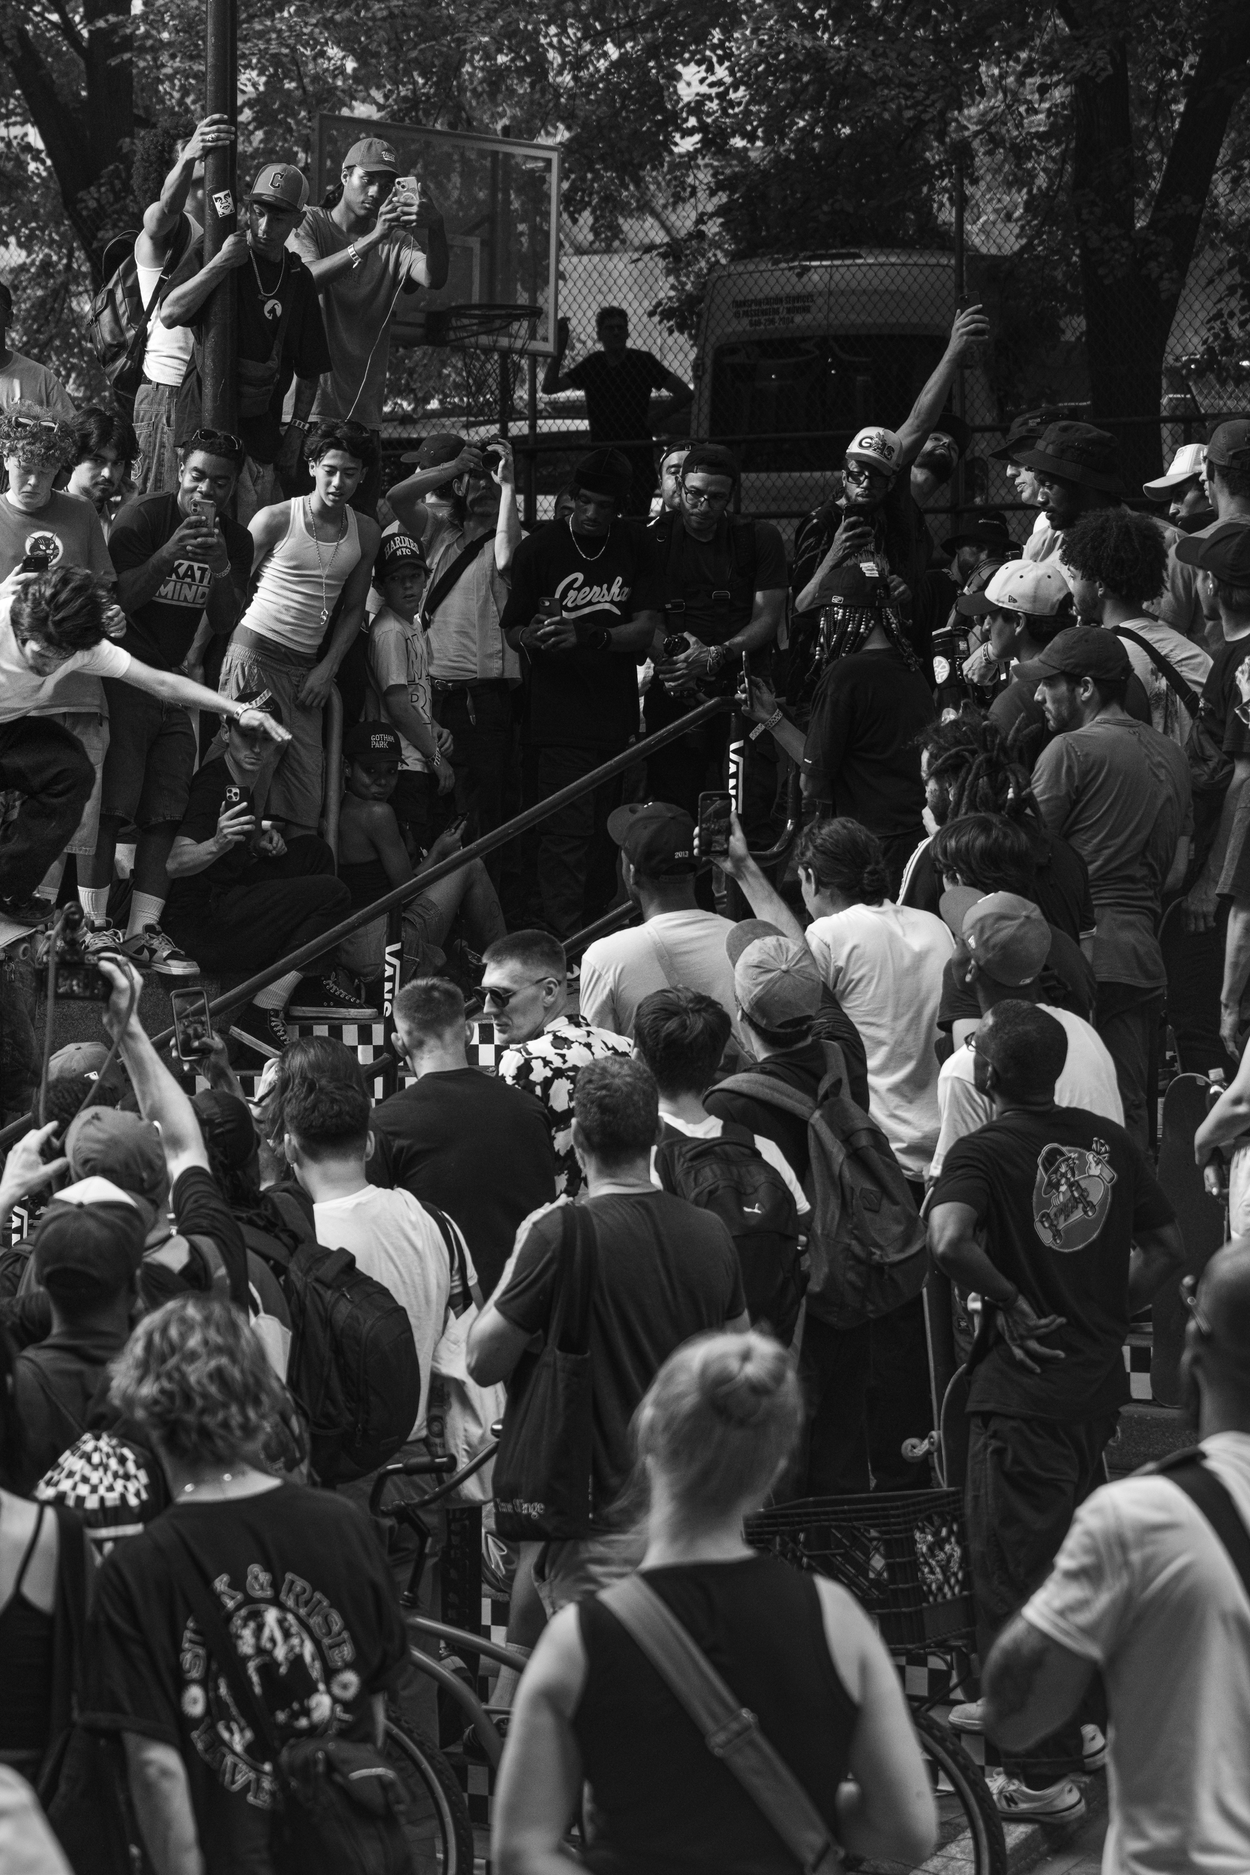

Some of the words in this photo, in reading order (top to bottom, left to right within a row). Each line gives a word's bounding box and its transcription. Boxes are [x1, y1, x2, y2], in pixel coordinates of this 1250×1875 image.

[269, 172, 285, 190] C
[396, 547, 411, 556] NYC
[166, 562, 212, 585] KAT
[554, 571, 632, 609] Crensha
[371, 741, 389, 749] PARK
[674, 851, 689, 859] 2013
[383, 942, 402, 1018] VANS
[180, 1572, 243, 1682] STK
[279, 1571, 355, 1670] RISE
